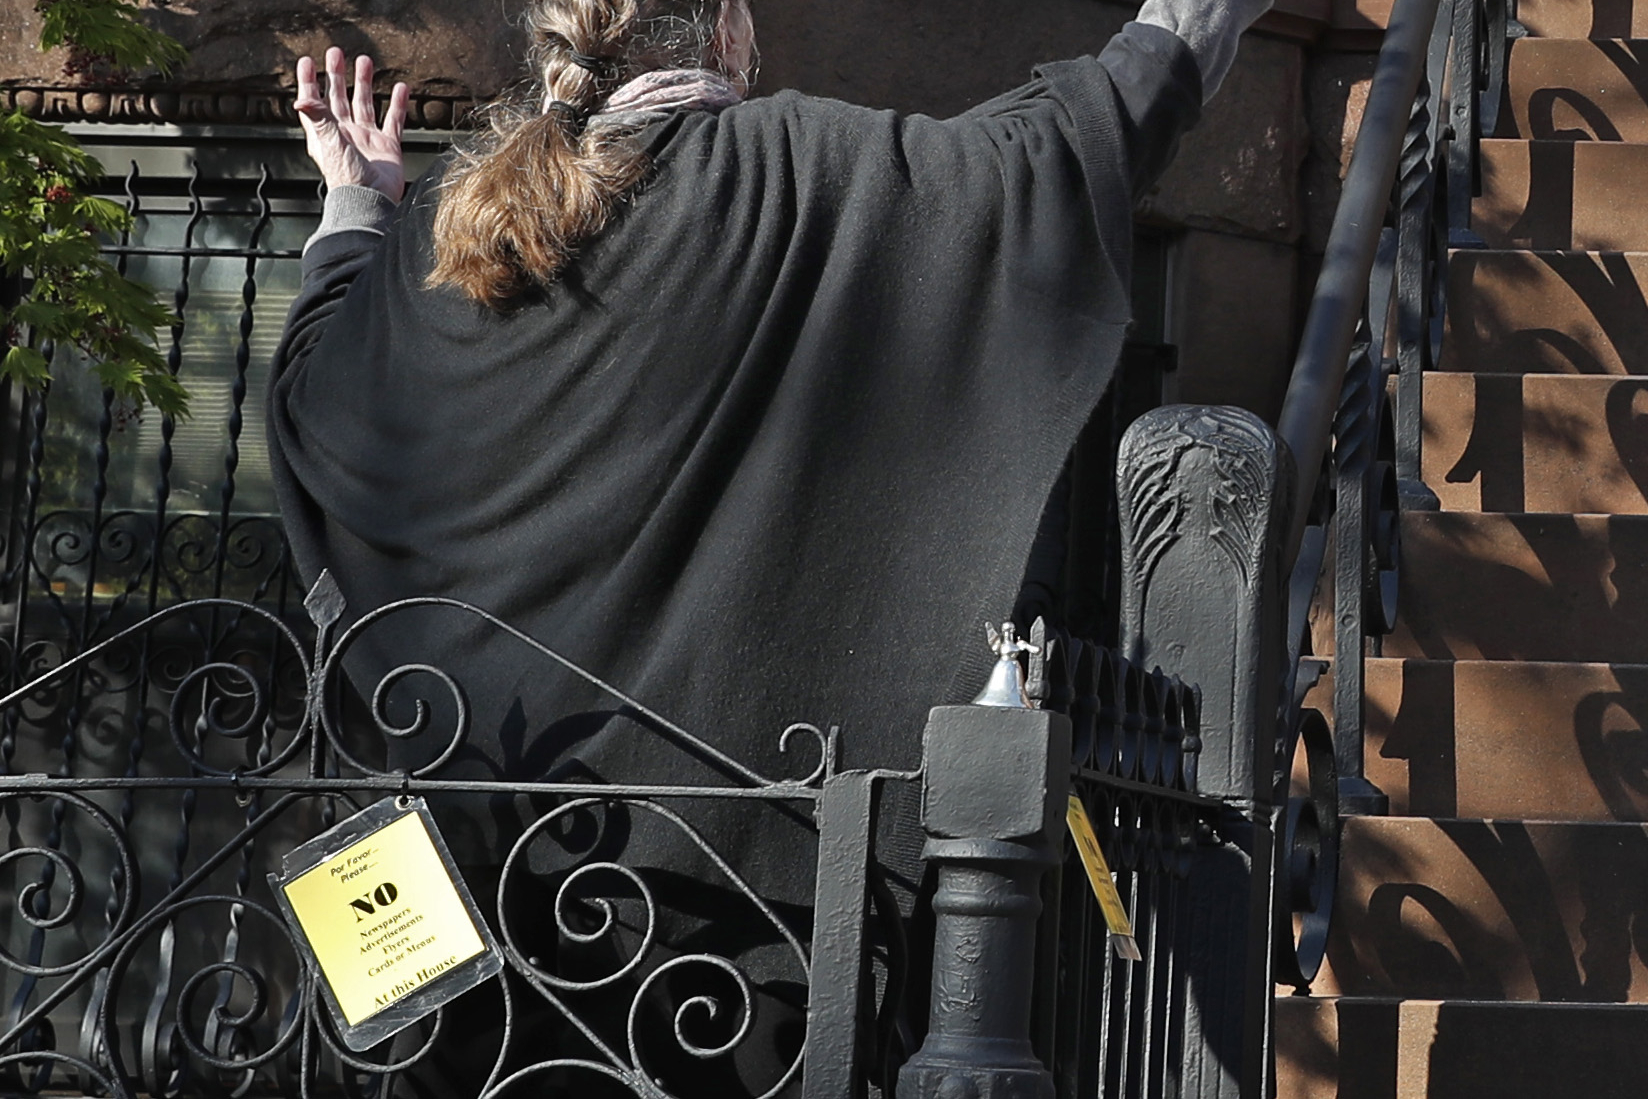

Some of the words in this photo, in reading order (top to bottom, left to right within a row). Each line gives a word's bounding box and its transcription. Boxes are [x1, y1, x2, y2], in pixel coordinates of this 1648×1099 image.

[330, 864, 345, 878] Por
[348, 882, 398, 924] NO
[360, 907, 411, 940] Newspapers
[360, 914, 424, 955] Advertisements
[382, 936, 410, 955] Flyers
[368, 959, 394, 977] Cards
[395, 953, 405, 962] or
[406, 935, 436, 956] Menus
[374, 993, 389, 1009] At
[391, 980, 415, 998] this
[416, 955, 457, 983] House
